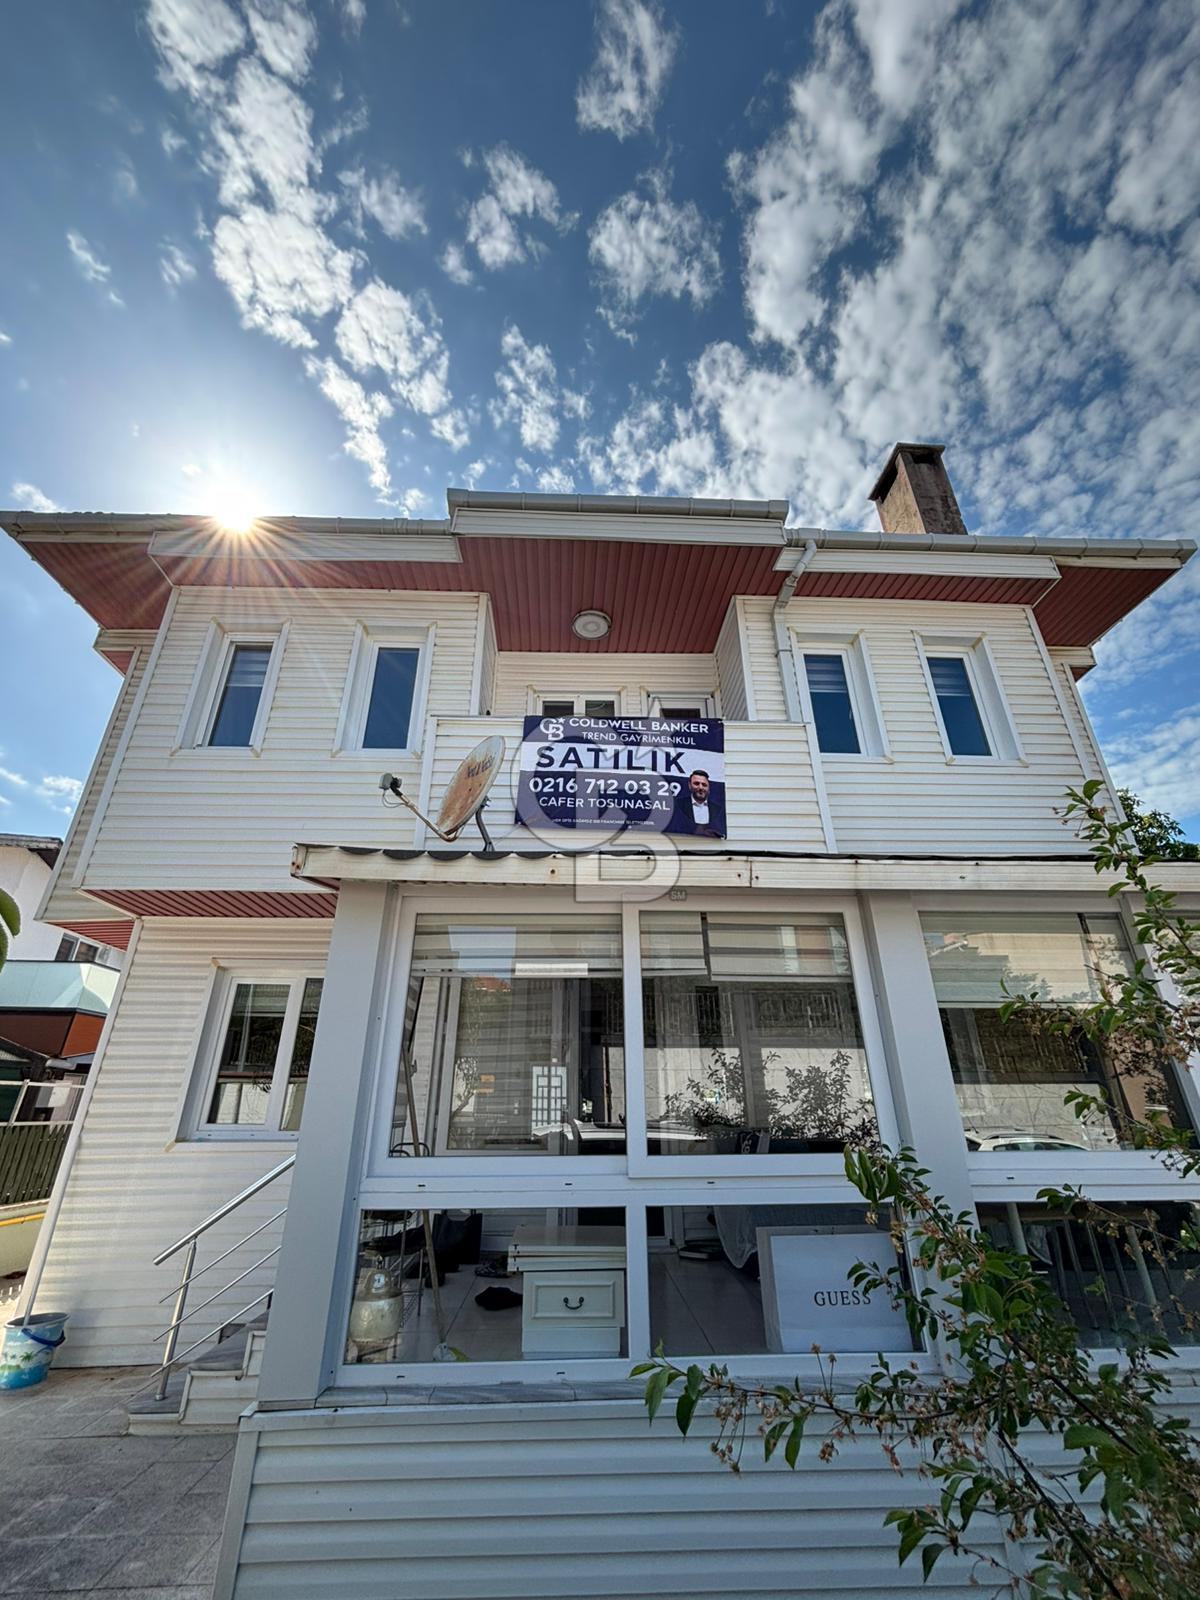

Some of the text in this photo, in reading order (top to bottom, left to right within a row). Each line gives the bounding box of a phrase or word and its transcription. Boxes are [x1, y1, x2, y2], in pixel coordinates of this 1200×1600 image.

[569, 717, 709, 734] COLDWELL BANKER
[582, 731, 617, 741] TREND
[536, 745, 686, 774] SATILIK
[529, 777, 682, 797] 0216 712 03 29
[539, 796, 671, 811] CAFER TOSUNASAL
[813, 1290, 871, 1307] GUESS
